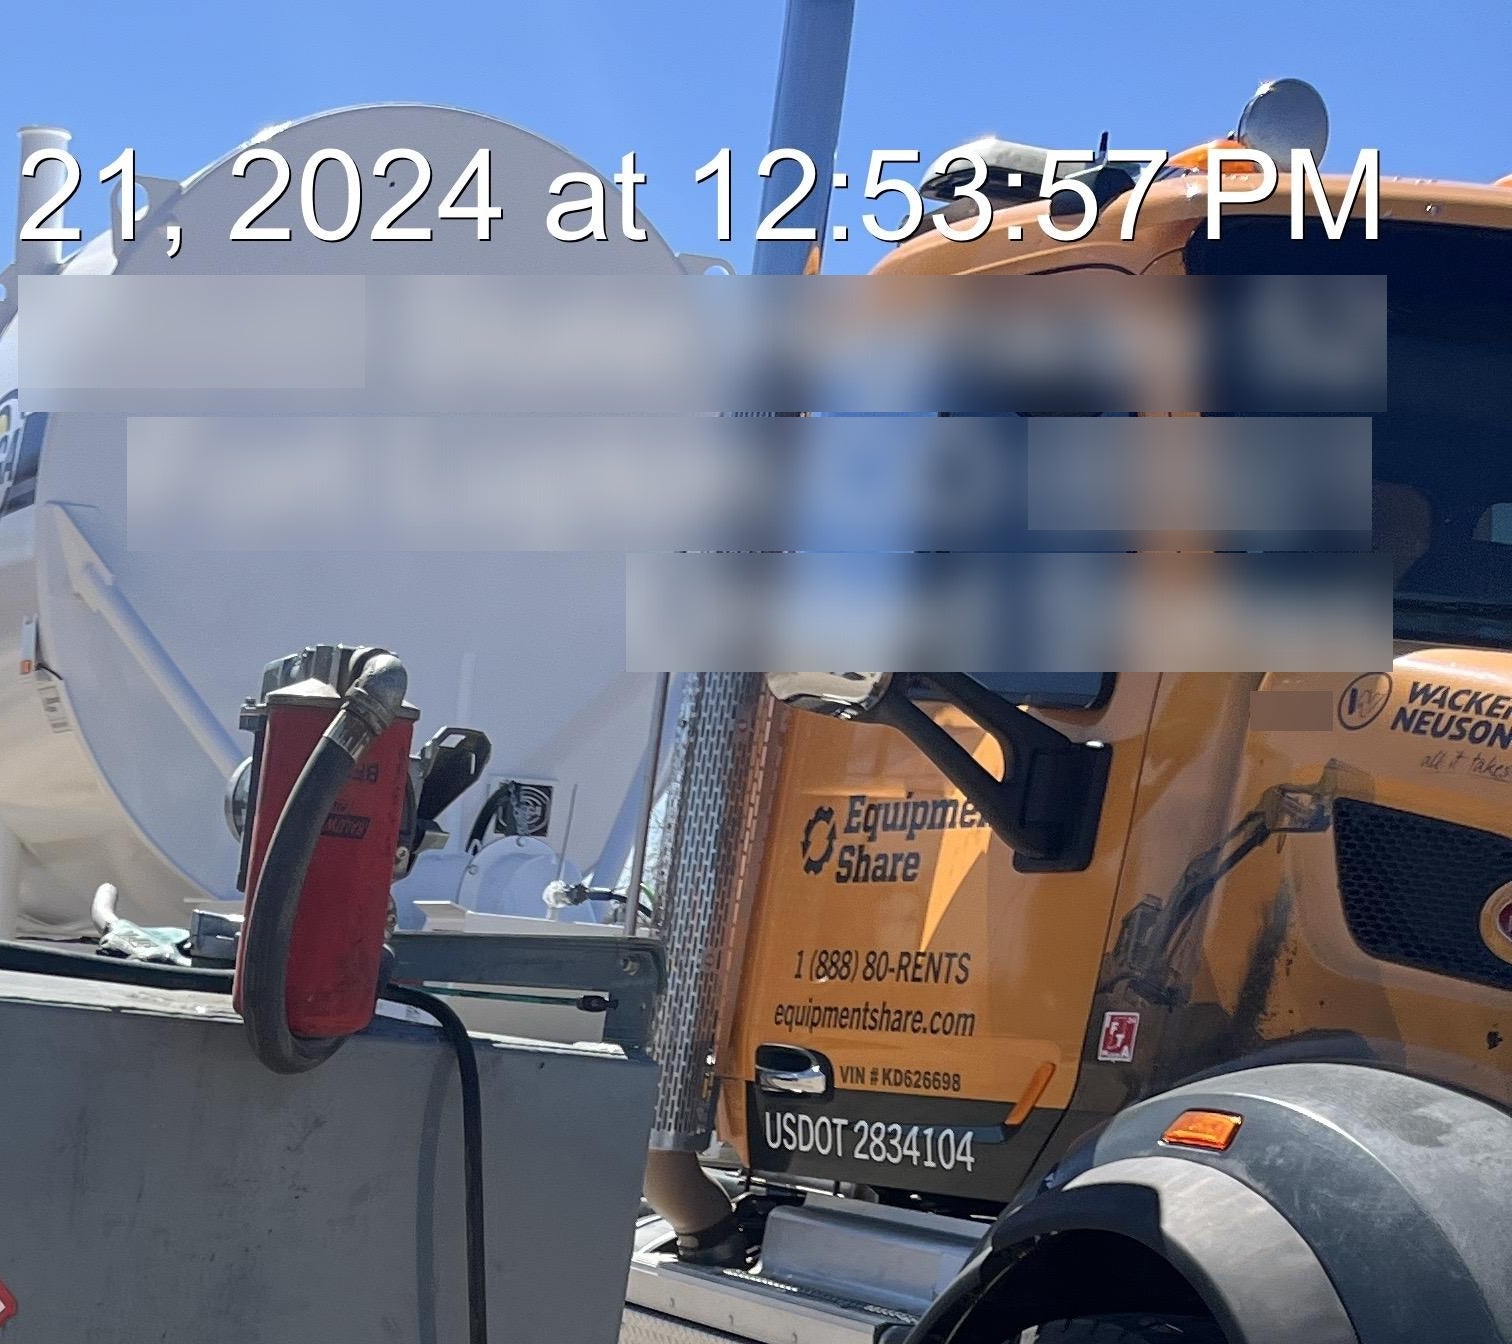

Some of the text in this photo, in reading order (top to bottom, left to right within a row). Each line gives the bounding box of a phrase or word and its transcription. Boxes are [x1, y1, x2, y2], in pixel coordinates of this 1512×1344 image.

[1390, 706, 1512, 750] NEUSON
[844, 792, 990, 842] Equipme
[836, 845, 921, 883] Share
[794, 950, 972, 984] 1 (888) 80-RENTS
[774, 998, 976, 1037] equipmentshare.com
[840, 1066, 865, 1085] VIN
[765, 1111, 976, 1172] USDOT 2834104
